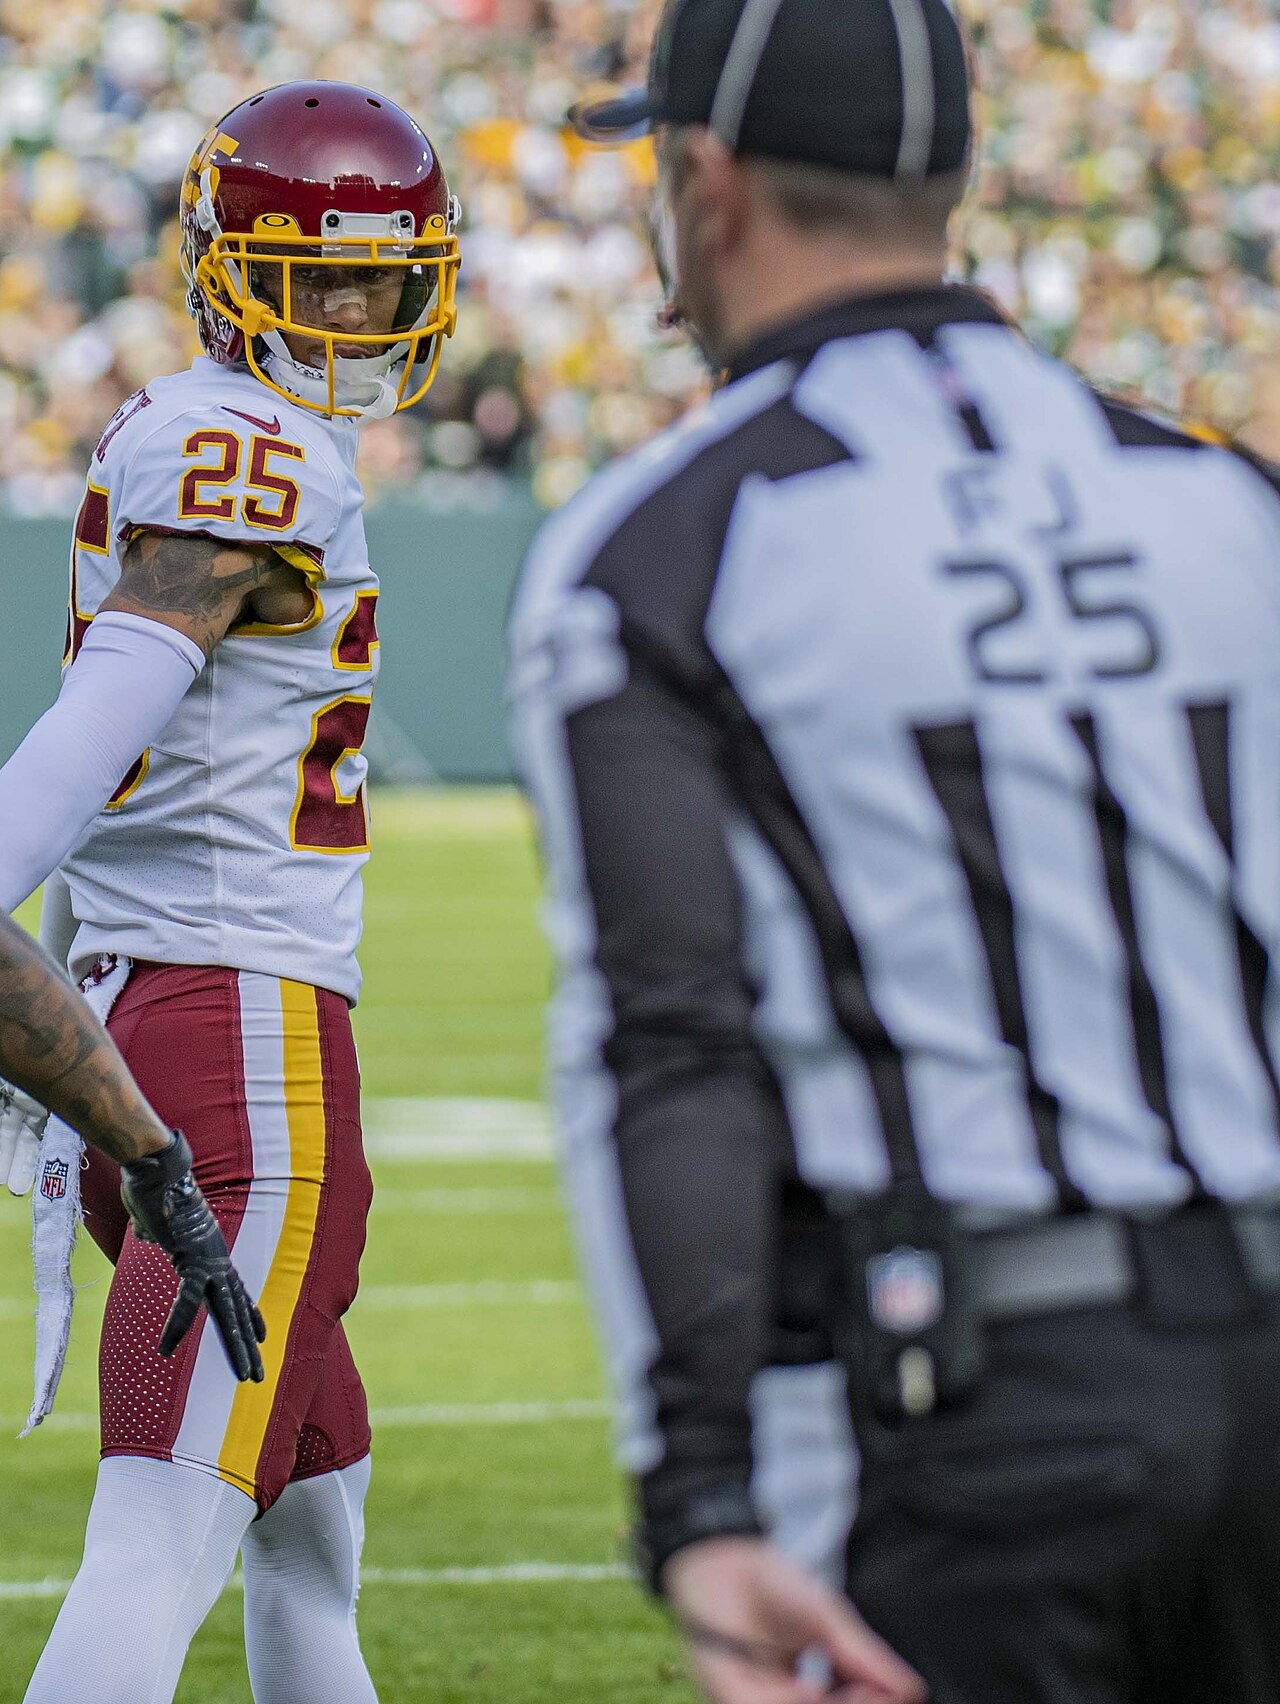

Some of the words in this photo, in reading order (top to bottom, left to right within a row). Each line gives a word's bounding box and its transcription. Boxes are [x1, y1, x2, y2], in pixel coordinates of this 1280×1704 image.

[178, 429, 306, 532] 25
[940, 549, 1160, 684] 25
[42, 1175, 64, 1197] NFL
